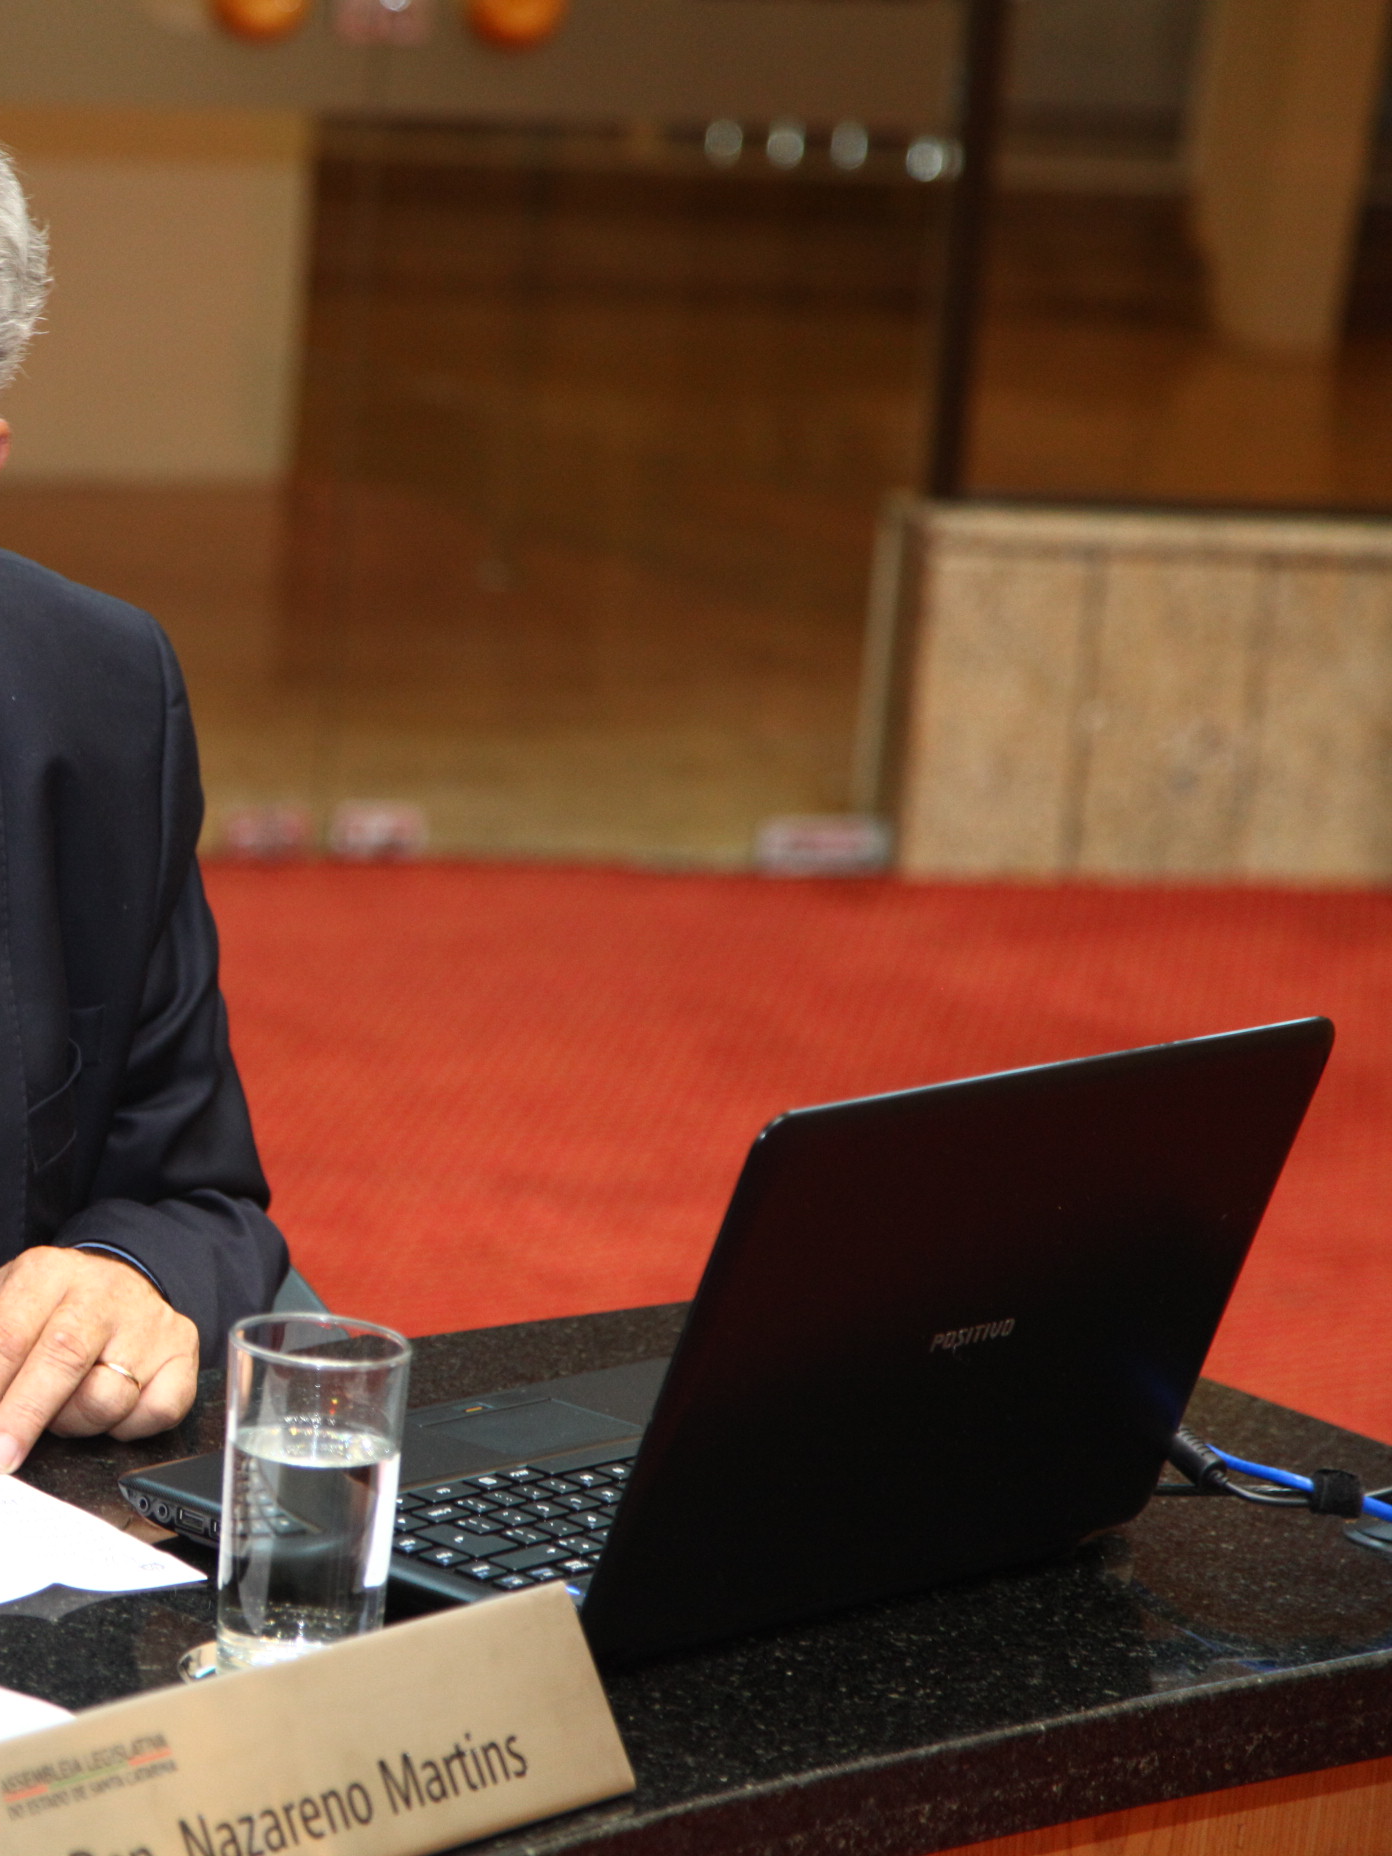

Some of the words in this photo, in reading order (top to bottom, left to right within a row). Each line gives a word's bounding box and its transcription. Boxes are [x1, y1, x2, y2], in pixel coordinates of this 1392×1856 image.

[929, 1317, 1016, 1353] POSITIVO
[178, 1781, 373, 1856] Nazareno
[377, 1732, 528, 1815] Martins
